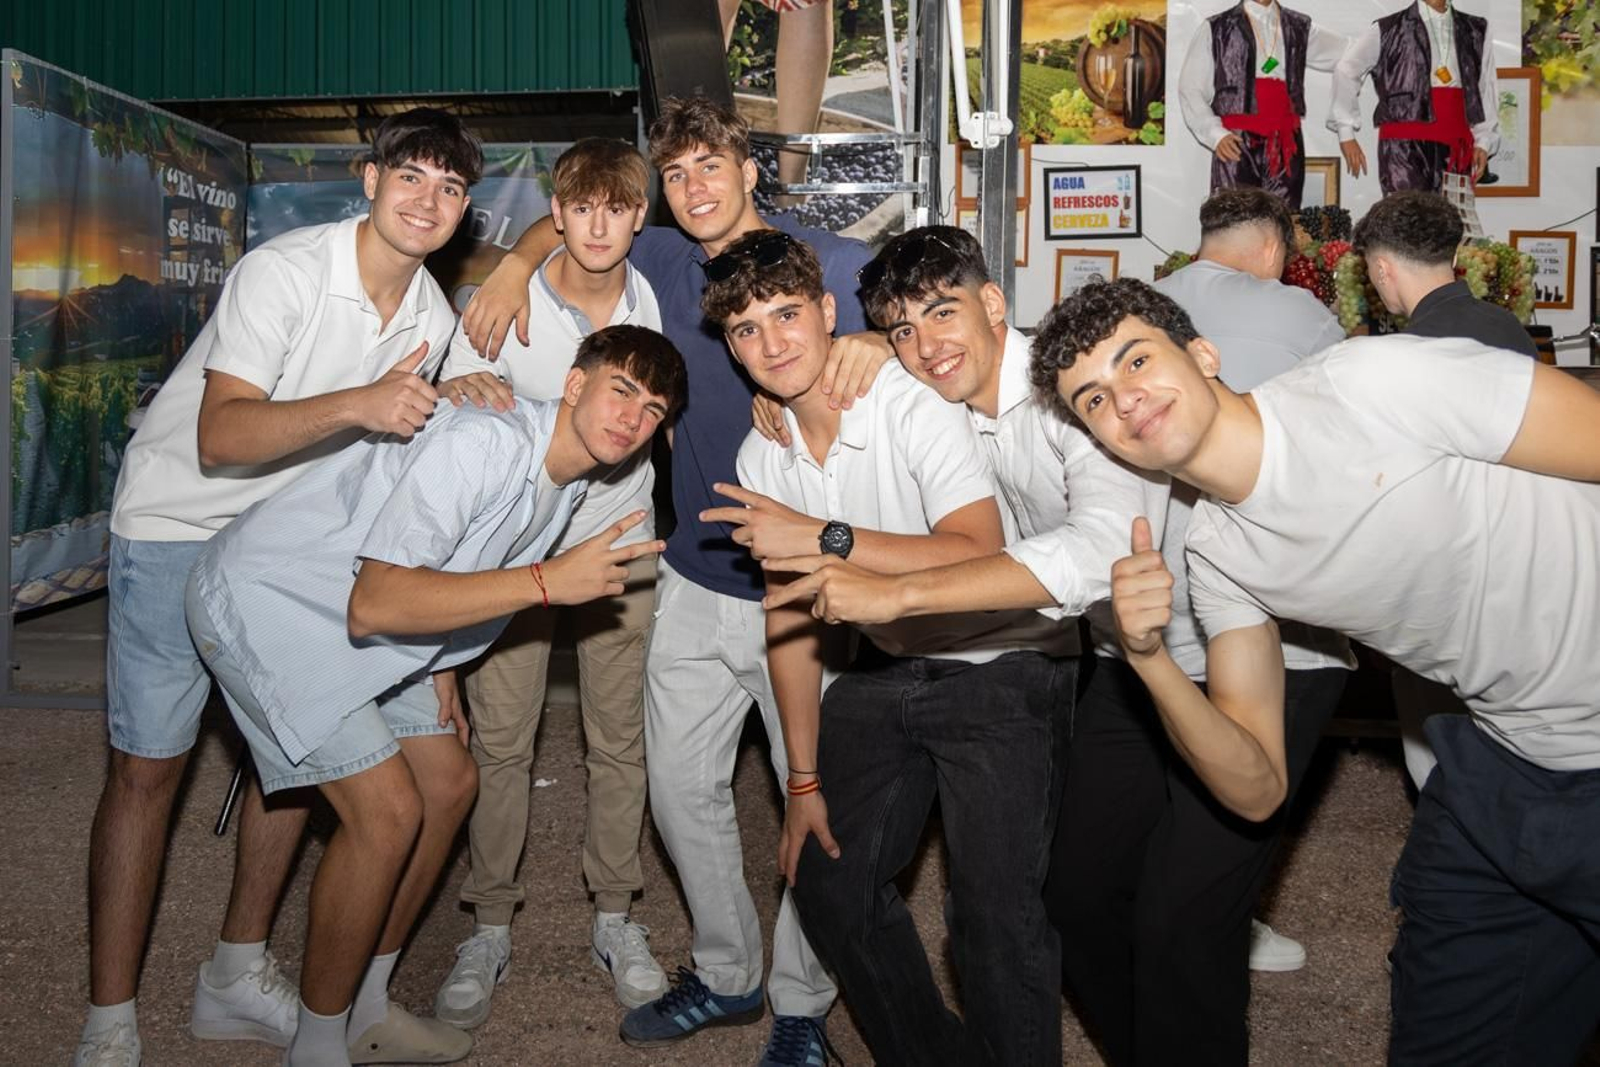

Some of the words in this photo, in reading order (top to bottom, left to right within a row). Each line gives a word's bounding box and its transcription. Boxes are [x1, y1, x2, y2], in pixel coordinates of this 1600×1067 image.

[1053, 177, 1085, 189] AGUA
[197, 181, 237, 209] vino
[1053, 195, 1119, 209] REFRESCOS
[167, 218, 189, 238] se
[192, 218, 232, 246] sirve
[1053, 214, 1109, 229] CERVEZA
[160, 258, 199, 287] muy
